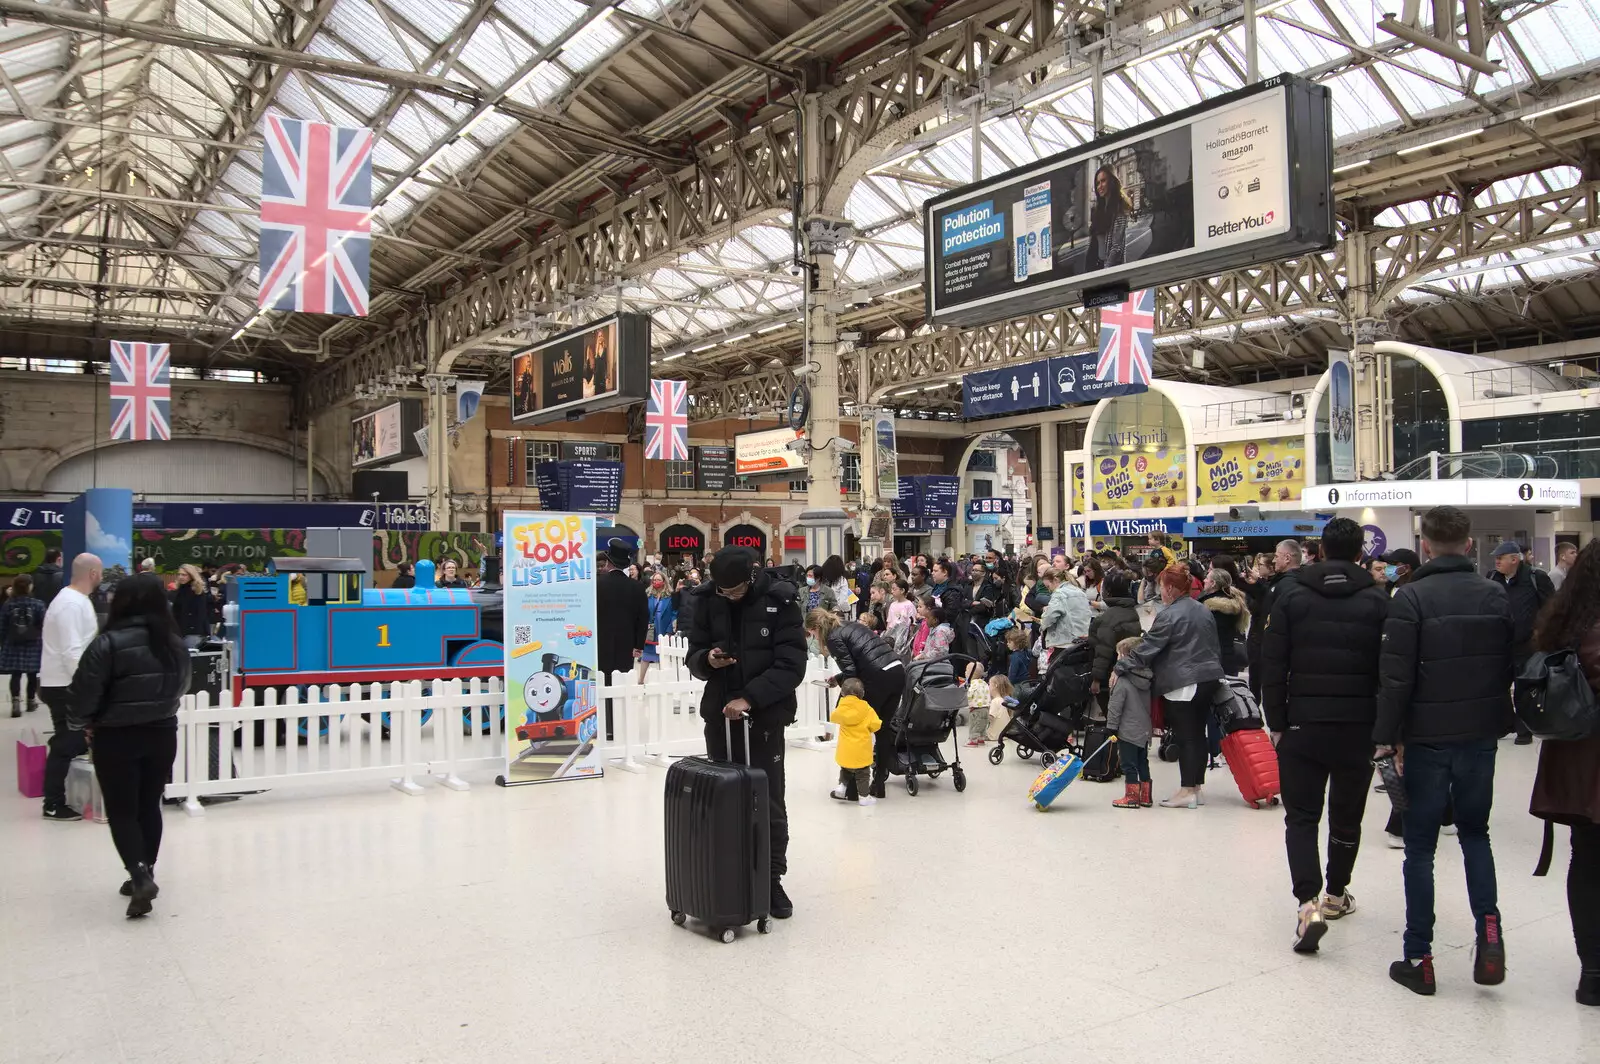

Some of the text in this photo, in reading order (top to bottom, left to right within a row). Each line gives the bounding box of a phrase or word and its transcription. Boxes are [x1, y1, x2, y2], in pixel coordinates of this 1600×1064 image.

[1264, 77, 1281, 88] 2776
[1221, 143, 1254, 159] amazon
[945, 208, 990, 232] Pollution
[1208, 215, 1265, 238] BetterYou
[945, 222, 1001, 252] protection
[945, 260, 962, 270] Combat
[969, 252, 991, 262] damaging
[945, 269, 958, 278] effects
[972, 261, 988, 271] particle
[951, 275, 968, 285] pollution
[953, 283, 964, 292] inside
[971, 382, 1001, 393] Please keep
[970, 392, 1003, 404] your distance
[1108, 428, 1168, 447] WHSmith
[574, 446, 597, 456] SPORTS
[1209, 457, 1239, 480] Mini
[1266, 460, 1282, 471] Mini
[1105, 468, 1130, 490] Mini
[1211, 470, 1243, 492] eggs
[1107, 480, 1134, 499] eggs
[1345, 489, 1412, 502] Information
[40, 511, 64, 524] Tic
[512, 515, 587, 552] STOP,
[1073, 524, 1084, 537] W
[1106, 519, 1168, 536] WHSmith
[668, 536, 699, 548] LEON
[732, 537, 760, 547] LEON
[134, 545, 266, 558] RIA STATION
[523, 540, 583, 564] LOOK
[513, 558, 536, 569] AND
[512, 558, 591, 586] LISTEN!
[376, 624, 391, 647] 1
